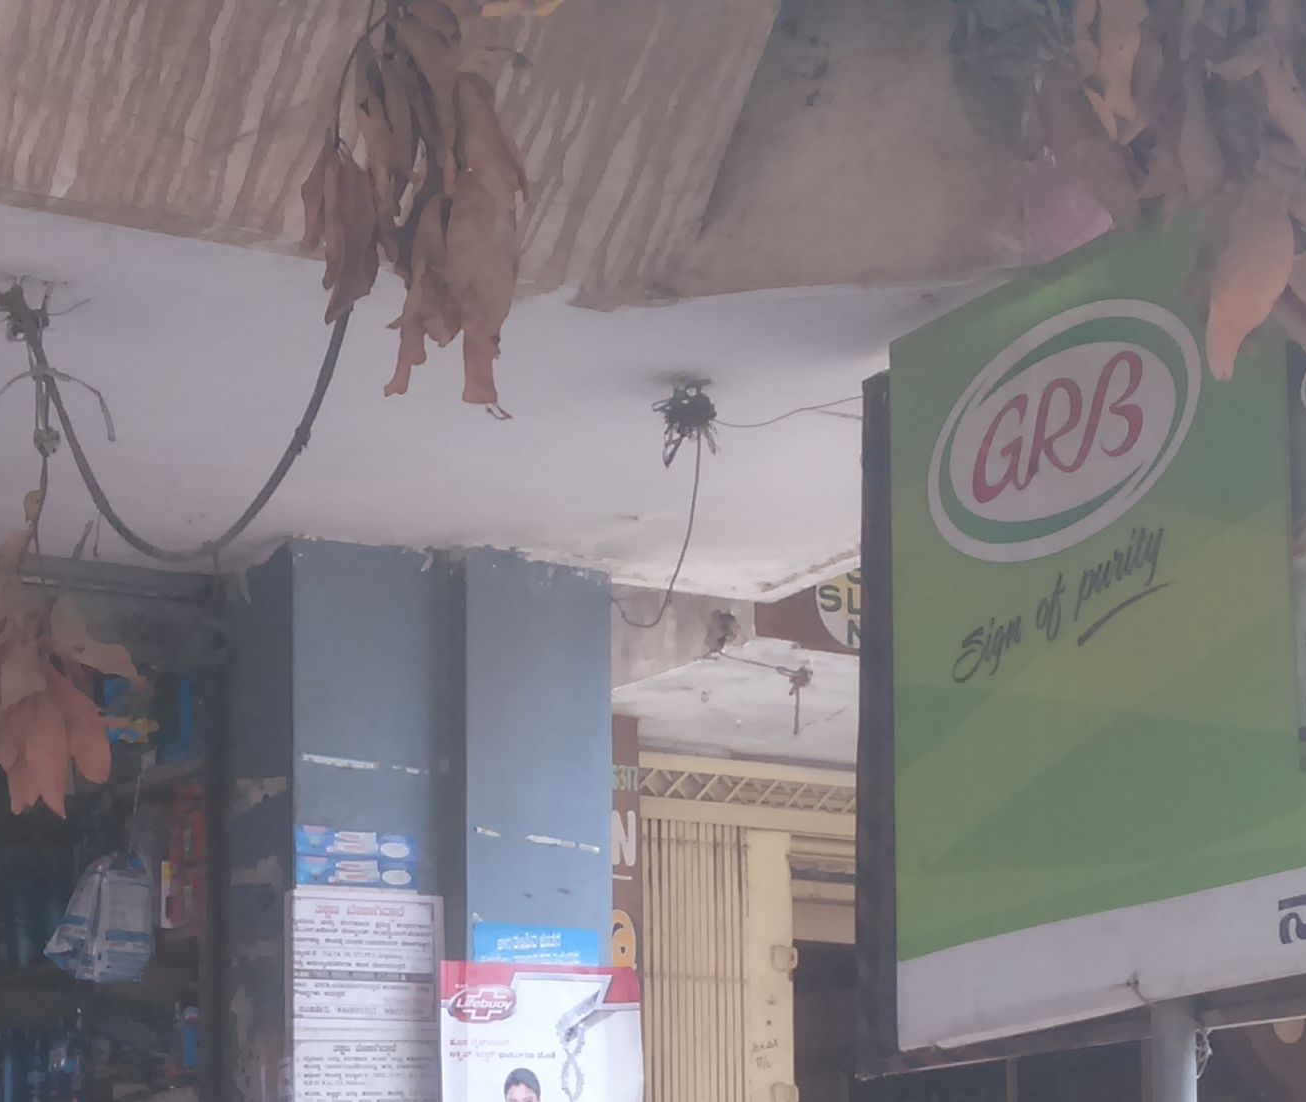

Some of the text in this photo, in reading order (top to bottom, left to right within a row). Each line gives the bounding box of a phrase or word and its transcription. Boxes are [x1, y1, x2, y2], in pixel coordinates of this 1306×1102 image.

[971, 350, 1144, 505] GRB
[952, 527, 1165, 684] Sign of purity
[456, 995, 514, 1013] Lifebuoy
